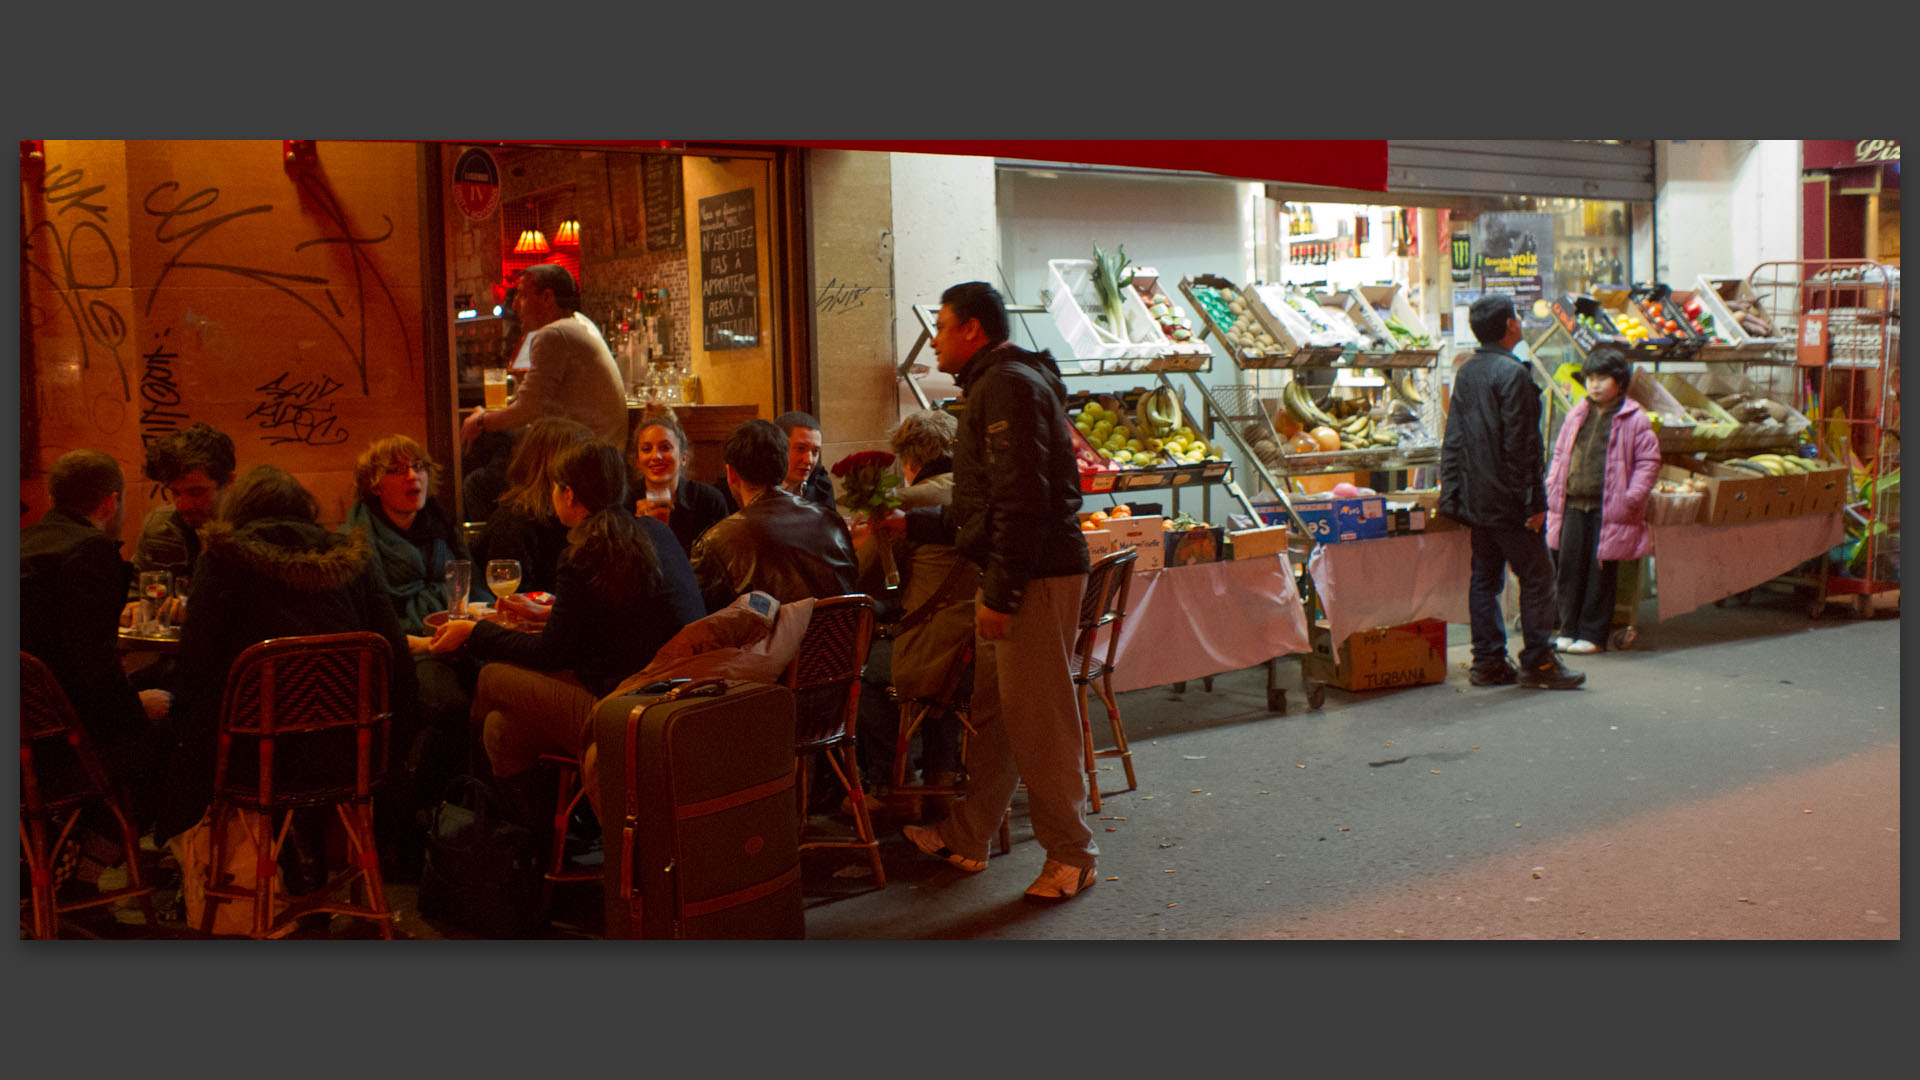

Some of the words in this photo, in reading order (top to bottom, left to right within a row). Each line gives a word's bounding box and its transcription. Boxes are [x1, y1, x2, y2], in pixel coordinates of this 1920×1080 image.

[712, 254, 727, 274] PAS
[1511, 251, 1538, 267] voix
[708, 297, 734, 319] REPAS
[1364, 668, 1426, 689] TURBANA
